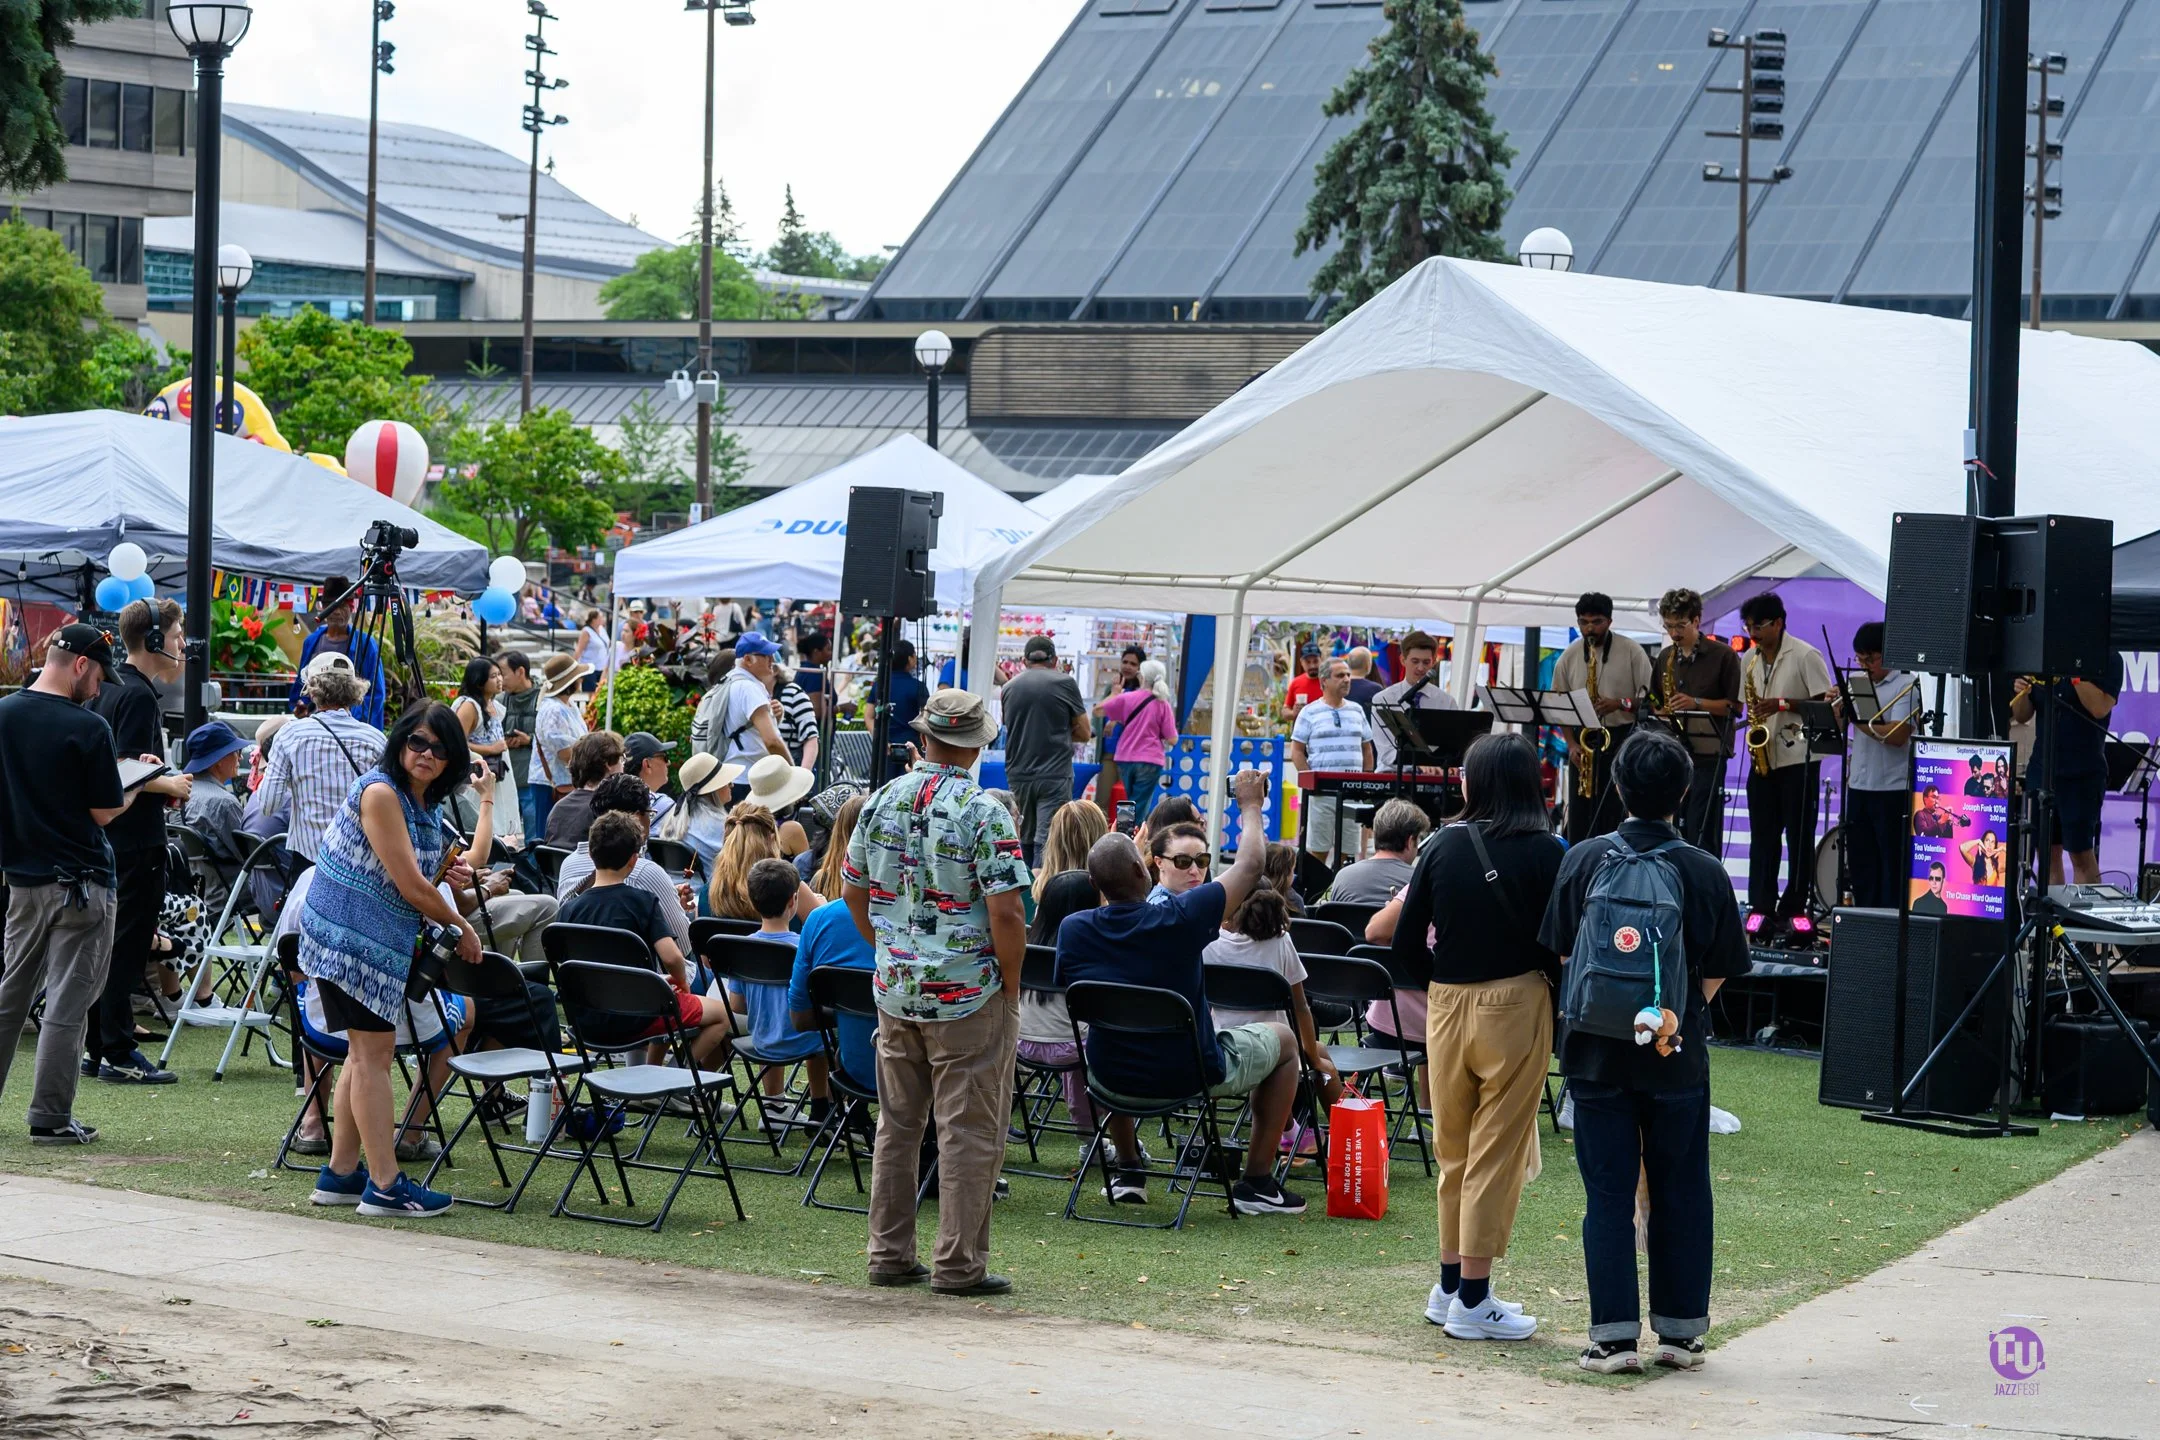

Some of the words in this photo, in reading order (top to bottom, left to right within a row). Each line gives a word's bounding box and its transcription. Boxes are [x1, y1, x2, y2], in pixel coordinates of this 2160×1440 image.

[1929, 766, 1934, 774] &
[1934, 766, 1953, 775] Friends
[1363, 782, 1384, 790] stage
[1962, 803, 1980, 813] Joseph
[1980, 804, 1993, 812] Funk
[1914, 843, 1923, 851] Tea
[1923, 844, 1946, 853] Valentina
[1946, 890, 1955, 898] The
[1955, 891, 1971, 901] Chase
[1971, 893, 1984, 902] Ward
[1984, 895, 2002, 904] Quintet
[1355, 1128, 1362, 1137] LA
[1344, 1153, 1351, 1161] IS
[1354, 1165, 1362, 1176] UN
[1343, 1178, 1351, 1195] FUN.
